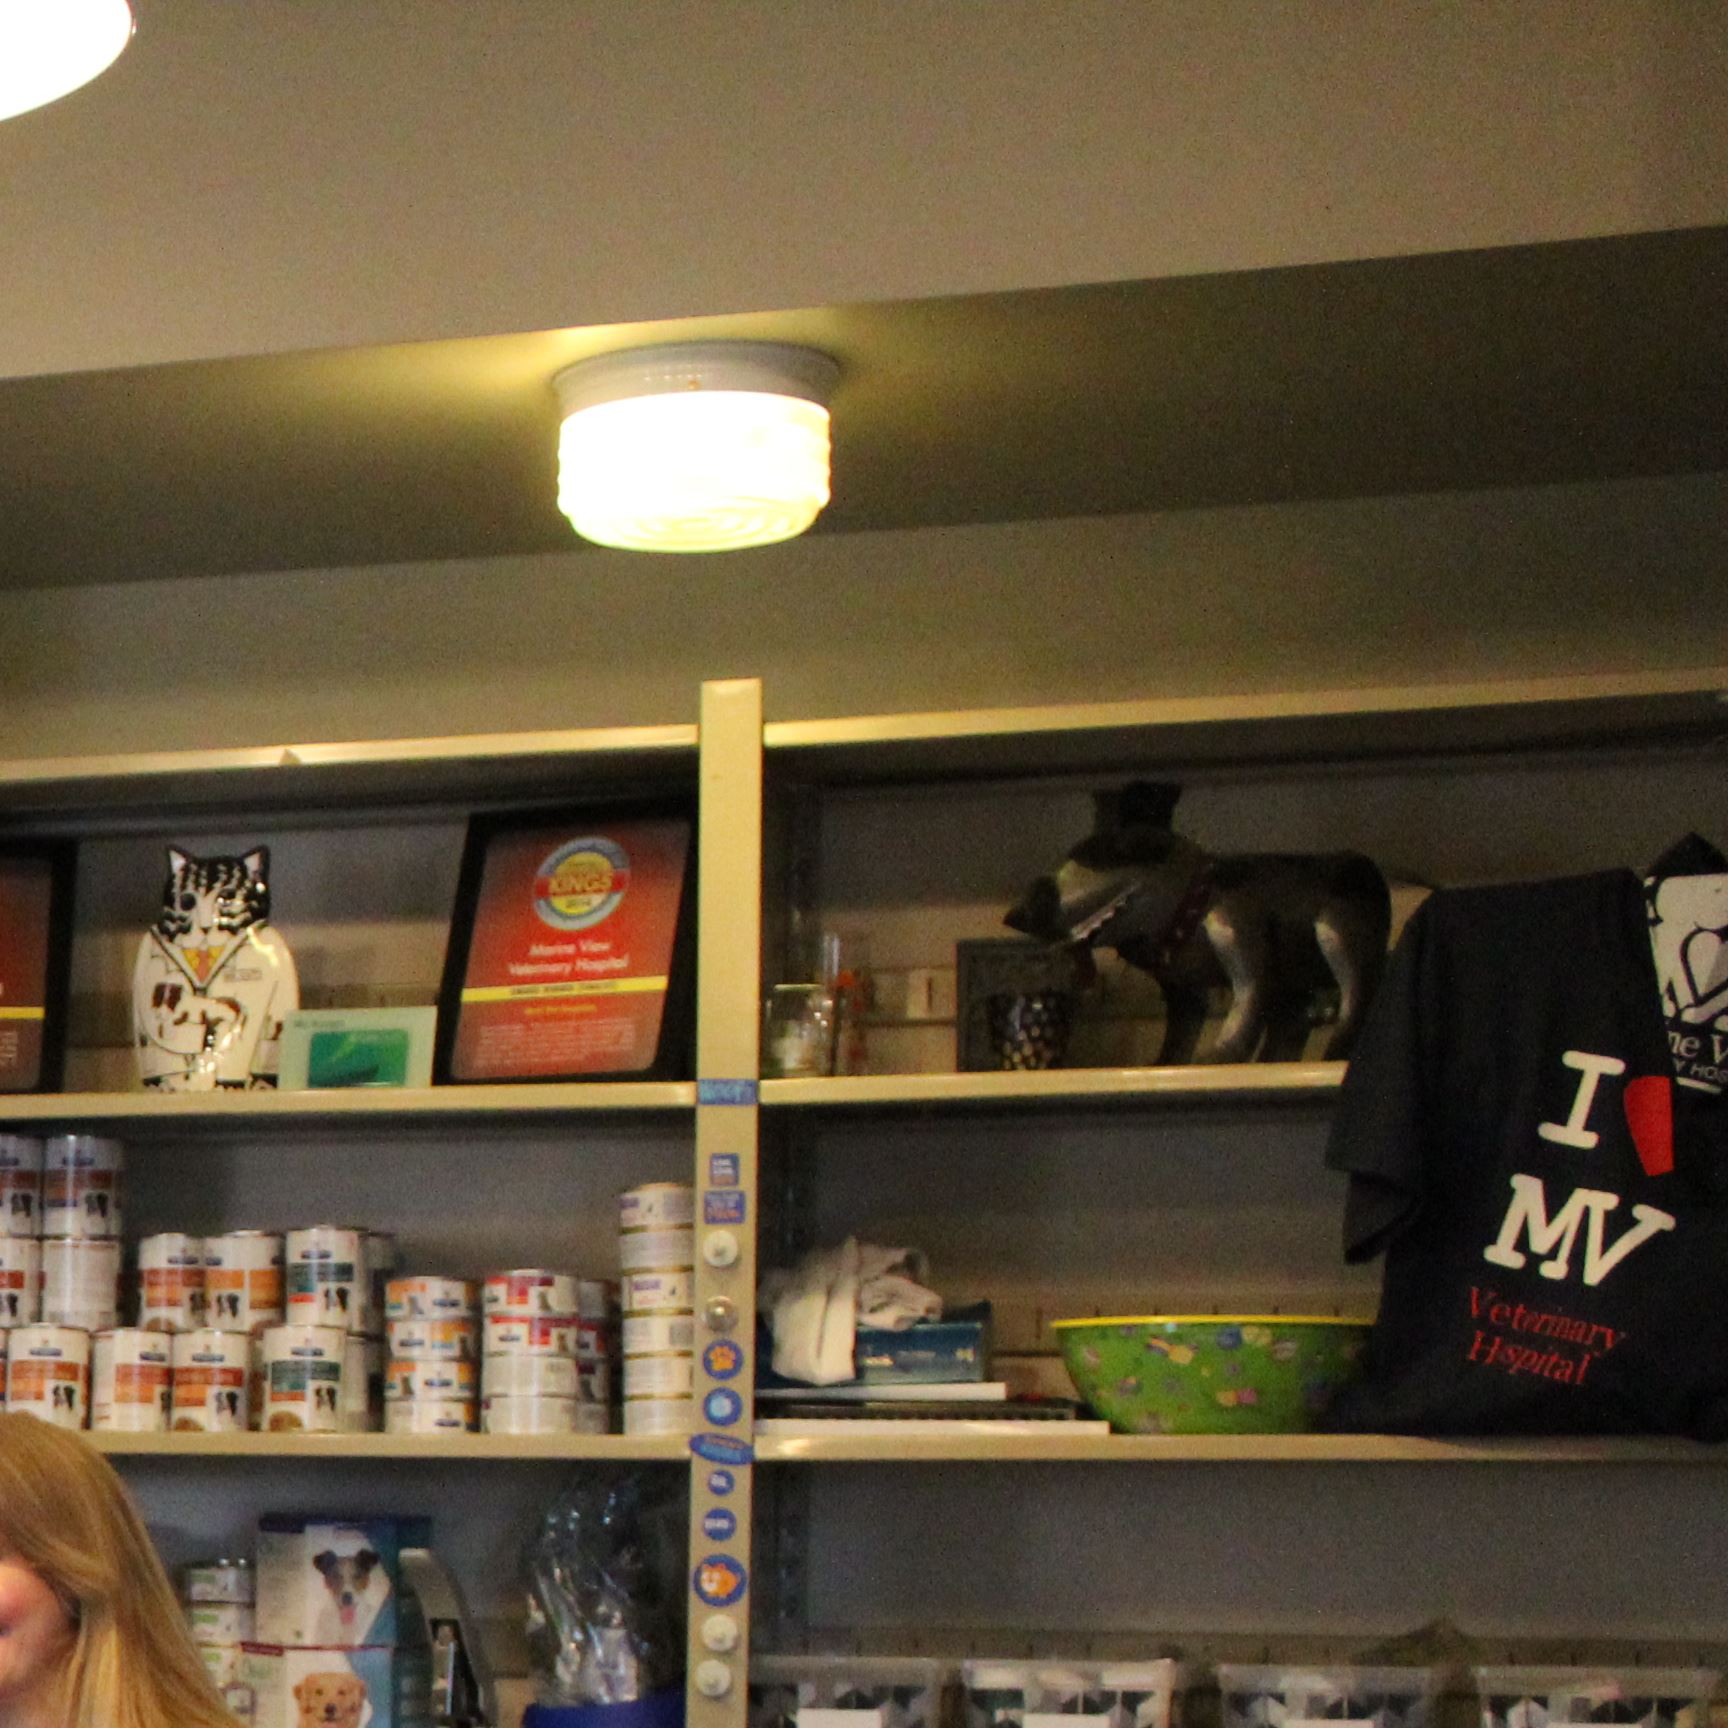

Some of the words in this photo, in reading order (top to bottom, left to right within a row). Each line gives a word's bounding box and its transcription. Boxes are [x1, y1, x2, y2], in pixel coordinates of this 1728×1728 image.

[1538, 1049, 1625, 1150] I
[1483, 1173, 1676, 1286] MV
[1468, 1286, 1625, 1352] Veterinary
[1468, 1330, 1590, 1385] Hspital
